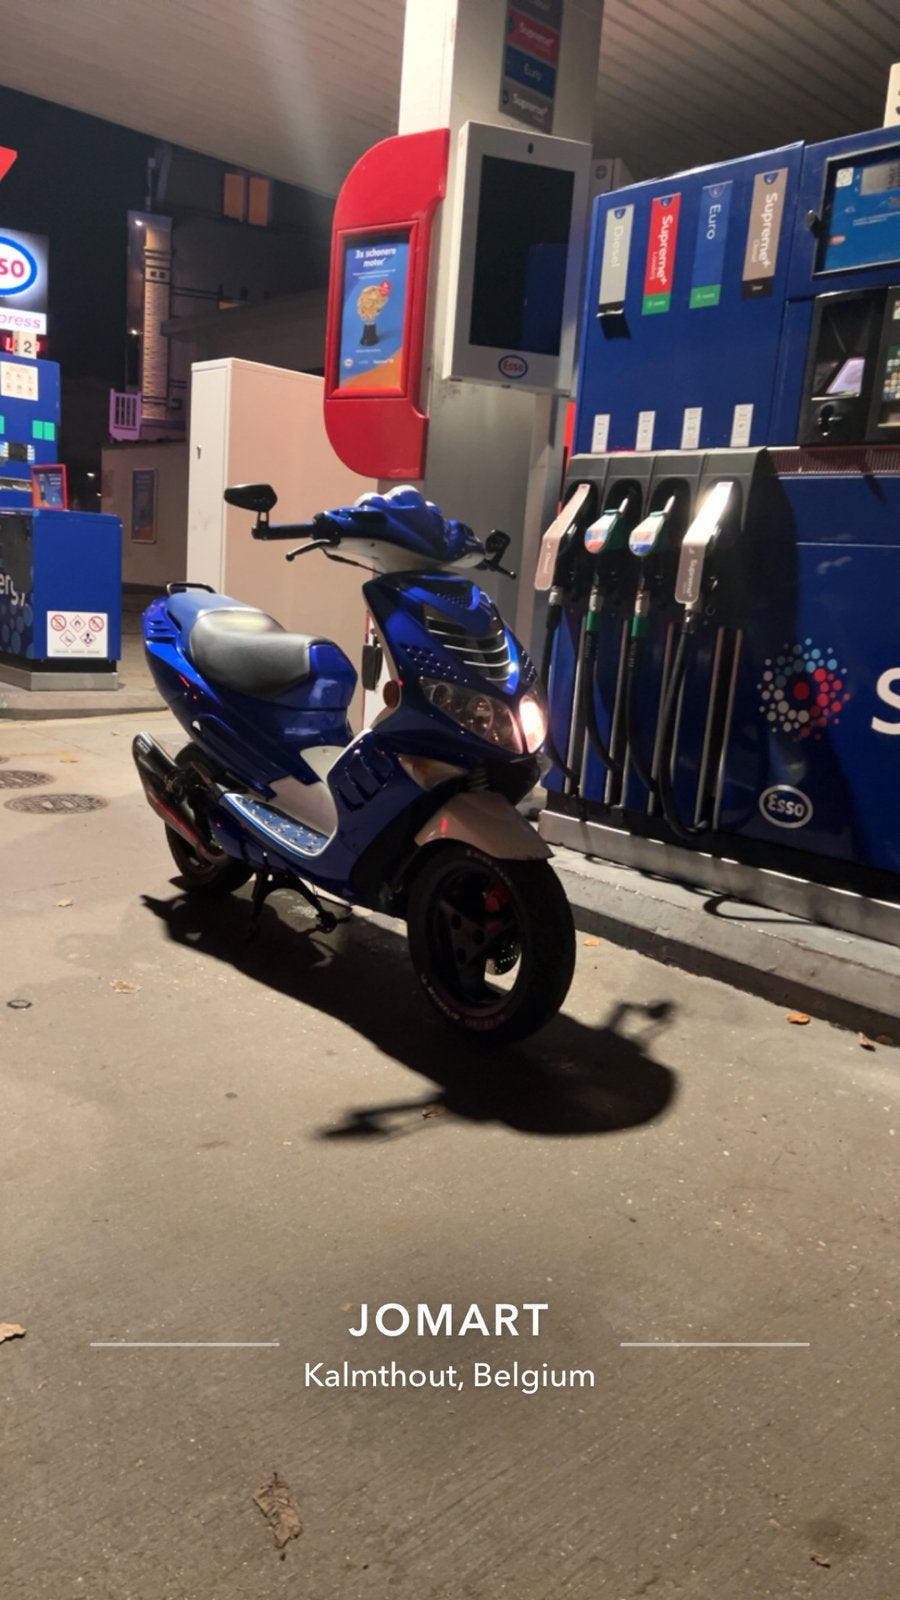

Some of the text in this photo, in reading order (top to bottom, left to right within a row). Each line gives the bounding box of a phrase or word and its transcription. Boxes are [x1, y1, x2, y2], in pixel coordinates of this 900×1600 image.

[706, 204, 722, 240] Euro
[611, 225, 624, 267] Diesel
[23, 340, 33, 354] 2
